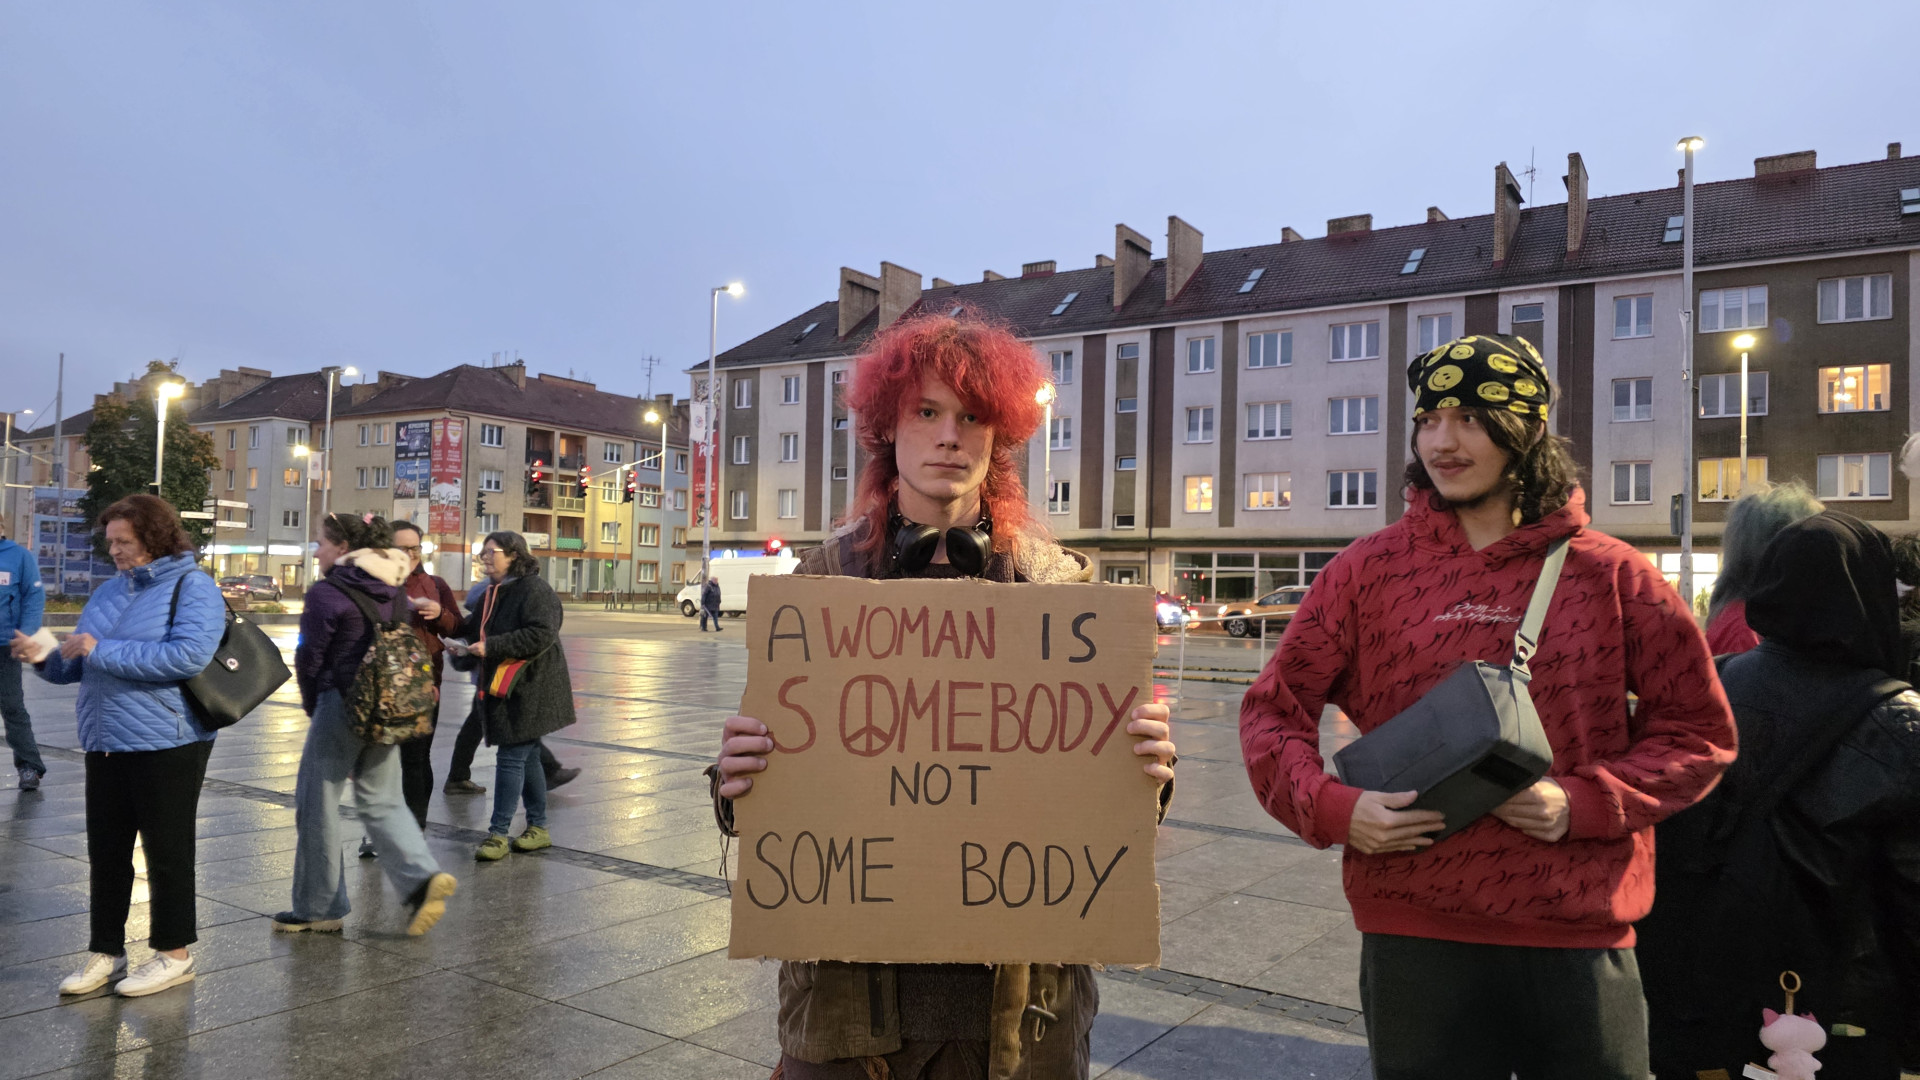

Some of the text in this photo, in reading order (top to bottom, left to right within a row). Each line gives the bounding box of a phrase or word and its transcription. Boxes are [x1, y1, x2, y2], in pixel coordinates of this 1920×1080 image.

[767, 604, 1097, 663] A WOMAN IS
[889, 761, 991, 806] NOT
[746, 831, 1128, 919] SOME BODY
